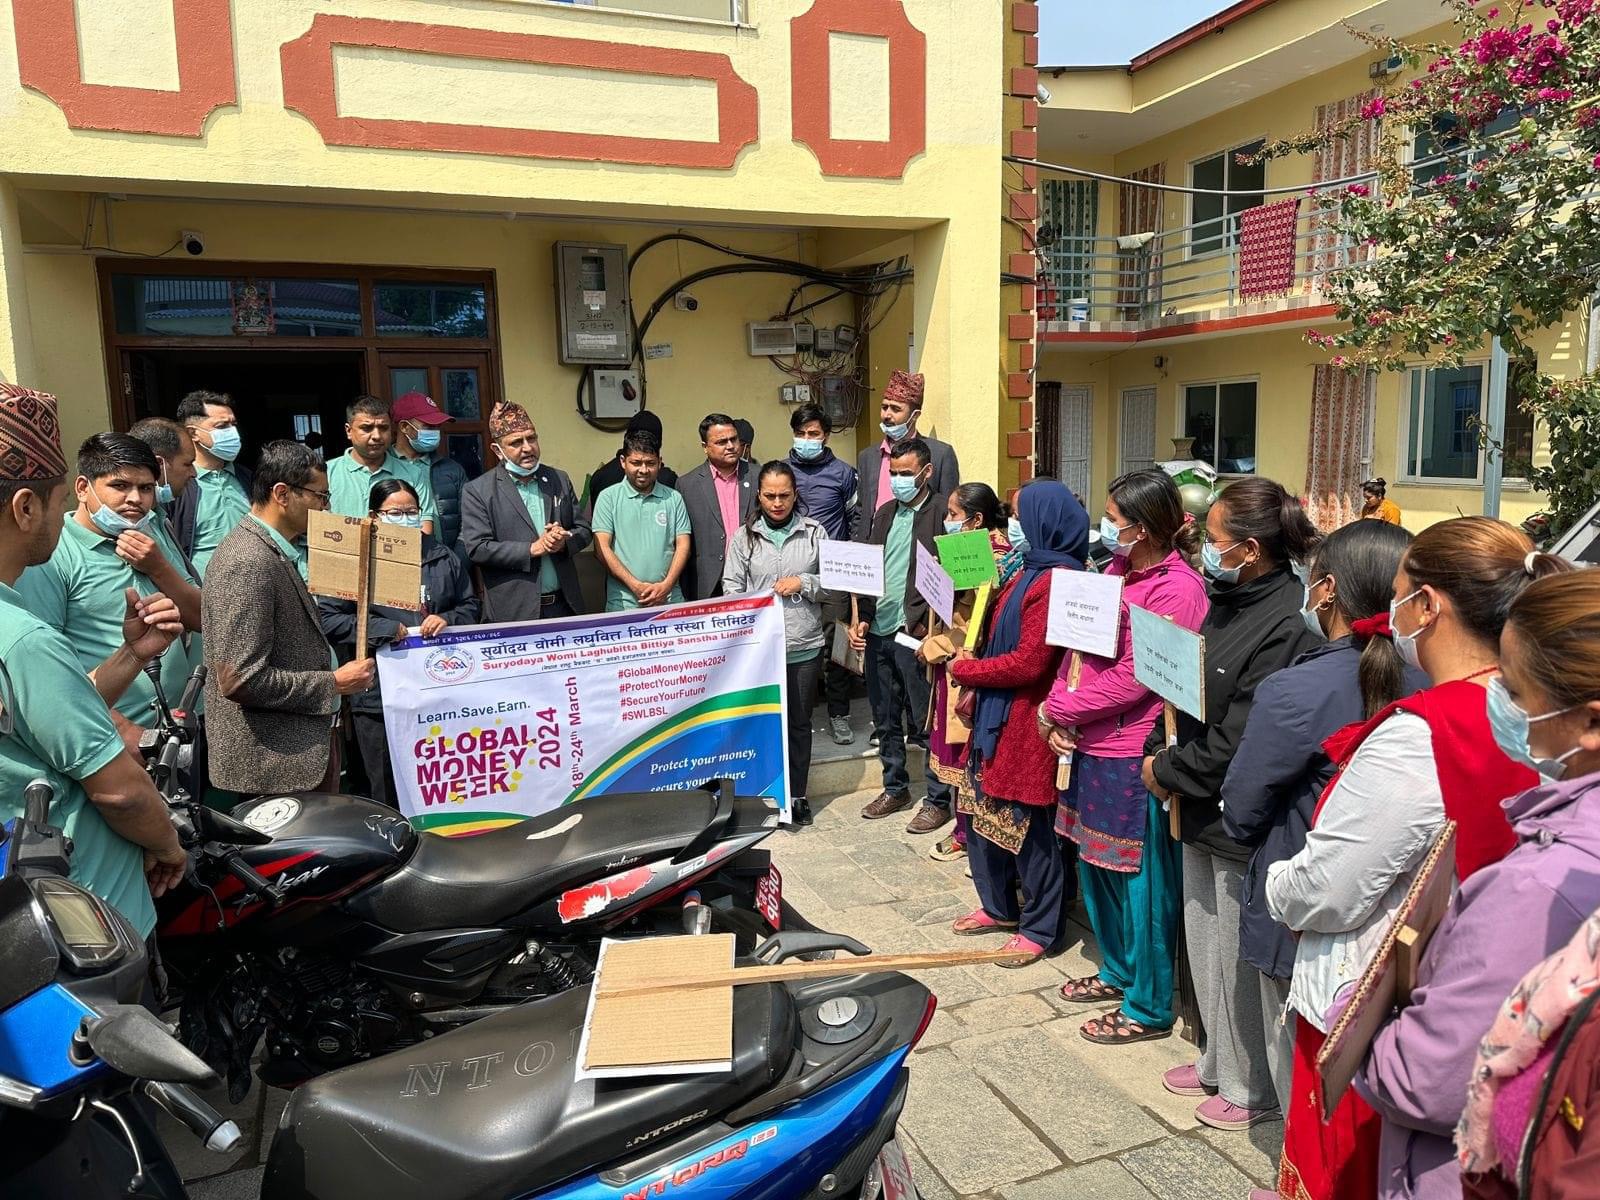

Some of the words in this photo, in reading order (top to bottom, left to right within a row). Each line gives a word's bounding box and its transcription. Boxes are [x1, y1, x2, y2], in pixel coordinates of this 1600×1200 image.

[480, 641, 529, 660] सूर्योदय
[535, 634, 567, 650] वोमी
[573, 628, 622, 648] लघुवित्त
[628, 625, 668, 639] वित्तीय
[674, 620, 706, 633] संस्था
[712, 613, 757, 629] लिमिटेड
[483, 657, 544, 671] Suryodaya
[546, 652, 577, 663] Womi
[580, 645, 638, 658] Laghubitta
[641, 639, 675, 651] Bittiya
[677, 634, 719, 645] Sanstha
[721, 628, 755, 640] Limited
[618, 655, 727, 679] #GlobalMoneyWeek2024
[619, 672, 708, 694] #ProtectYourMoney
[620, 686, 706, 708] #SecureYourFuture
[417, 701, 531, 724] Learn.Save.Earn.
[565, 676, 582, 726] March
[622, 706, 669, 722] #SWLBSL
[414, 725, 537, 760] GLOBAL
[536, 707, 561, 770] 2024
[416, 748, 527, 785] MONEY
[650, 757, 689, 775] Protect
[690, 756, 717, 771] your
[718, 748, 757, 761] money,
[420, 772, 511, 806] WEEK
[686, 775, 712, 790] your
[678, 858, 706, 879] 150
[400, 1025, 585, 1097] NTO
[633, 1109, 709, 1144] NTORQ
[752, 1128, 775, 1145] 125
